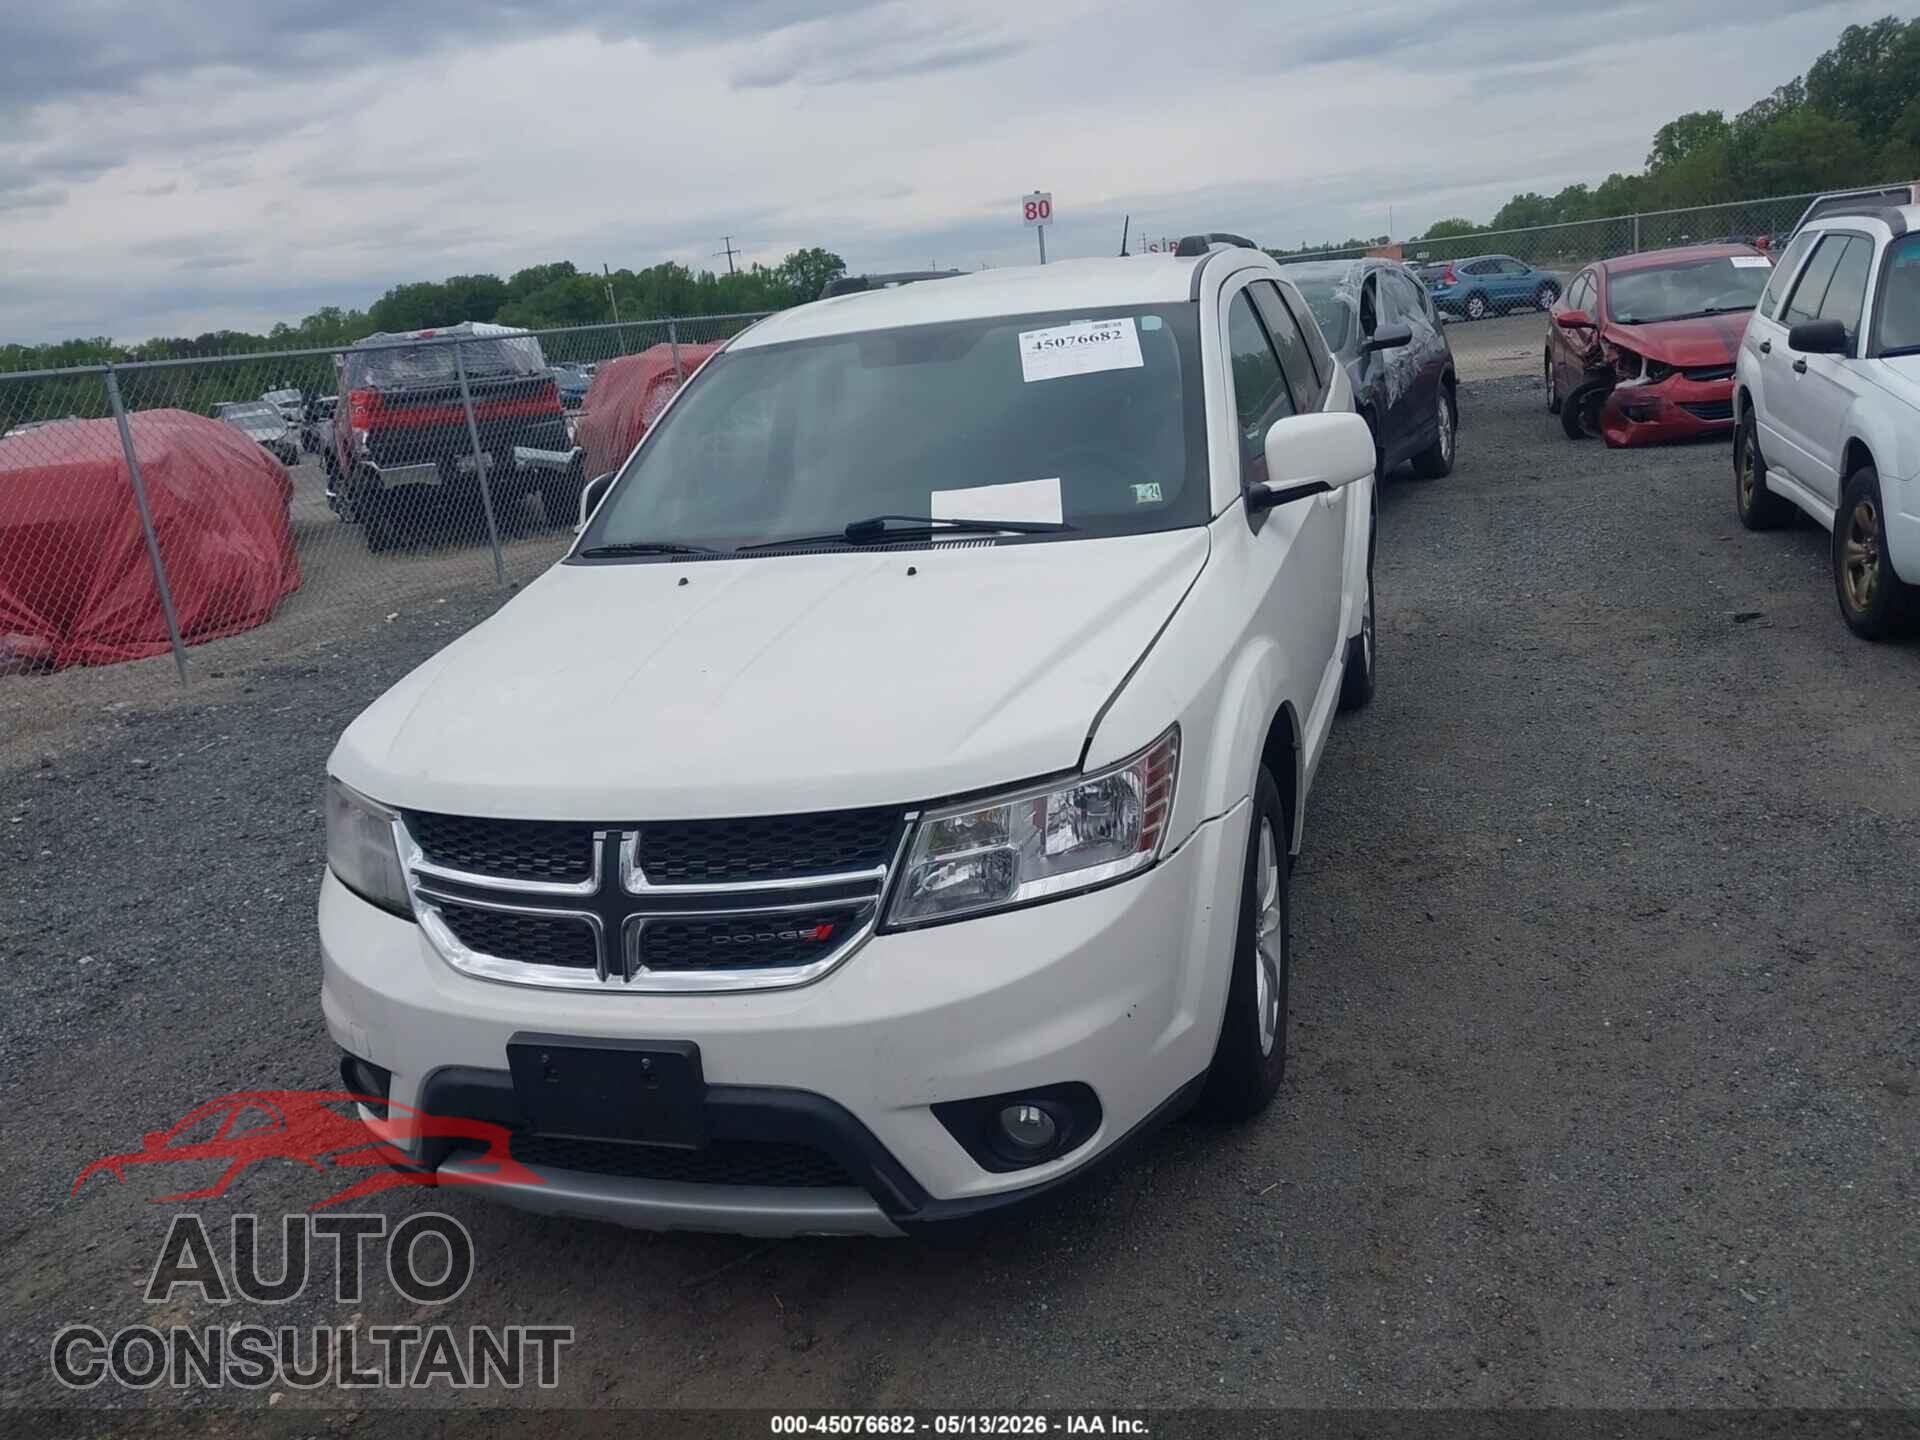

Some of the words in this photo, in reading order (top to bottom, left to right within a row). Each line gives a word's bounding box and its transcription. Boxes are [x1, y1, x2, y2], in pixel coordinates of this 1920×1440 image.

[1025, 200, 1050, 220] 80
[1032, 330, 1122, 350] 45076682
[711, 928, 818, 944] DODGE
